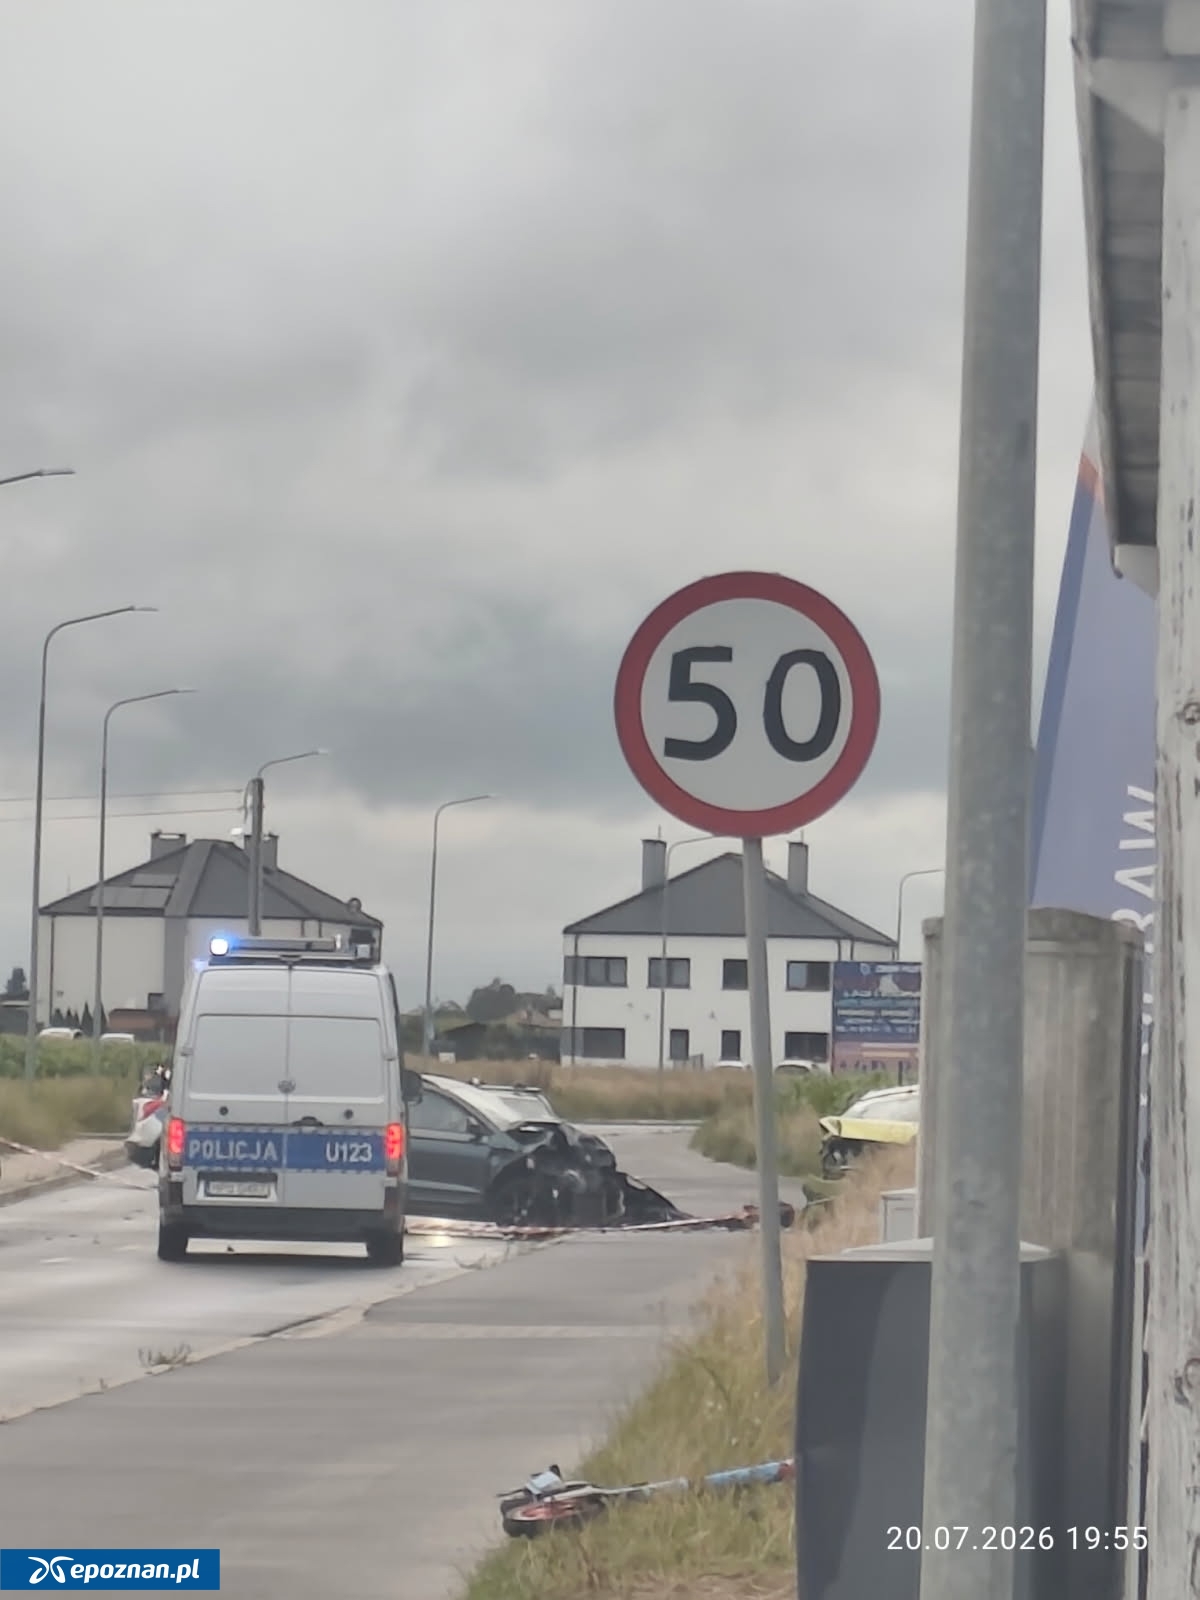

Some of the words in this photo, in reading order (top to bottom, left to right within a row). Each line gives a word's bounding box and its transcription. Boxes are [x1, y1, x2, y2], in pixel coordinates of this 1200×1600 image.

[664, 645, 841, 762] 50
[188, 1139, 278, 1162] POLICJA
[325, 1142, 373, 1163] U123
